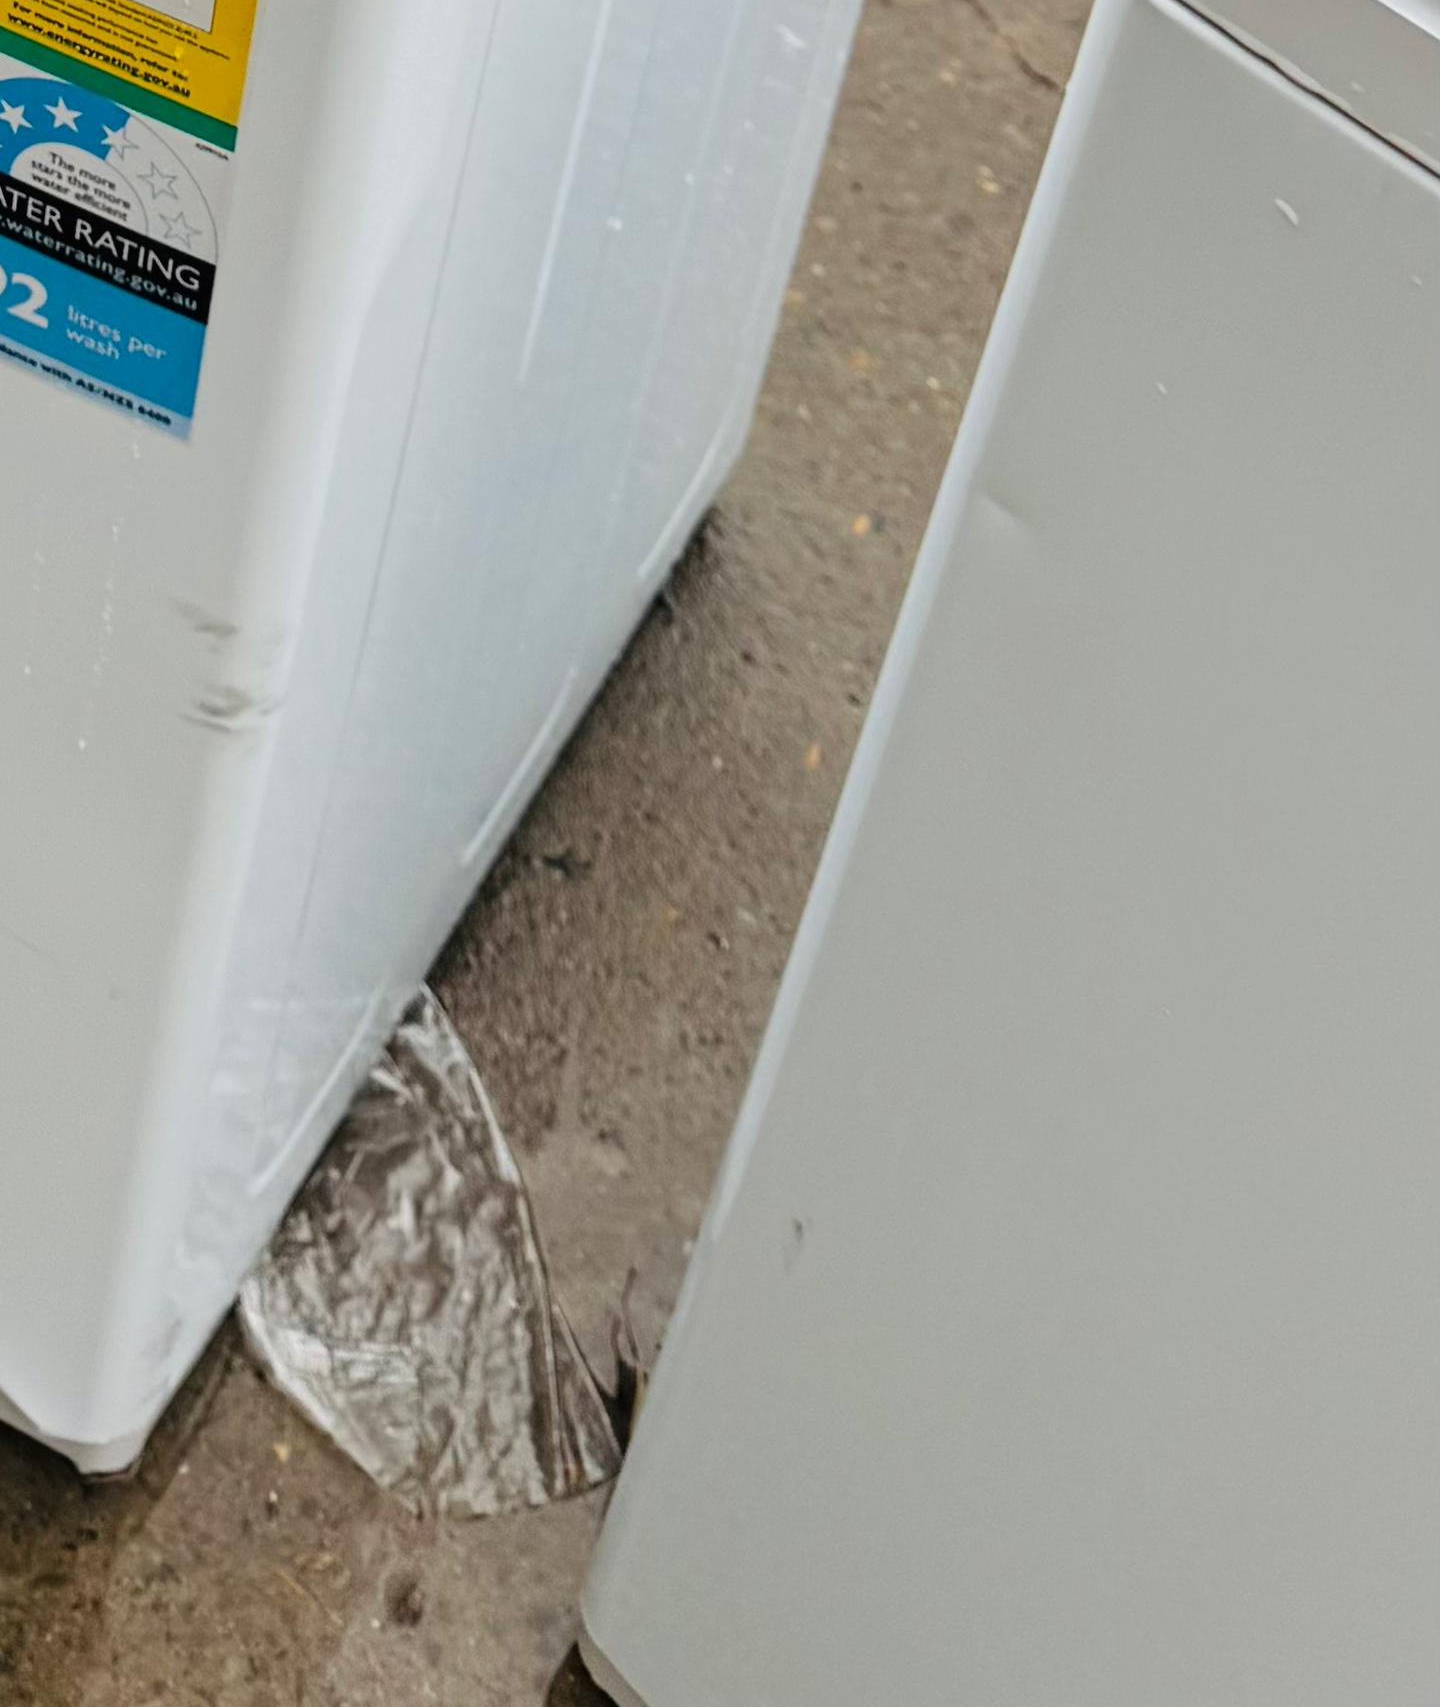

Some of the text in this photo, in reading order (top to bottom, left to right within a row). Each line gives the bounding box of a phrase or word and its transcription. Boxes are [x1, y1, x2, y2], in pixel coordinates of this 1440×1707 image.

[8, 13, 190, 98] www.energyrating.gov.au
[13, 1, 32, 14] For
[34, 12, 64, 28] more
[67, 25, 137, 61] information,
[140, 57, 168, 72] refer
[31, 160, 131, 211] stars the more
[32, 173, 127, 221] water efficient
[50, 152, 116, 191] The more
[75, 219, 200, 290] RATING
[67, 329, 119, 359] wash
[68, 305, 166, 361] litres per
